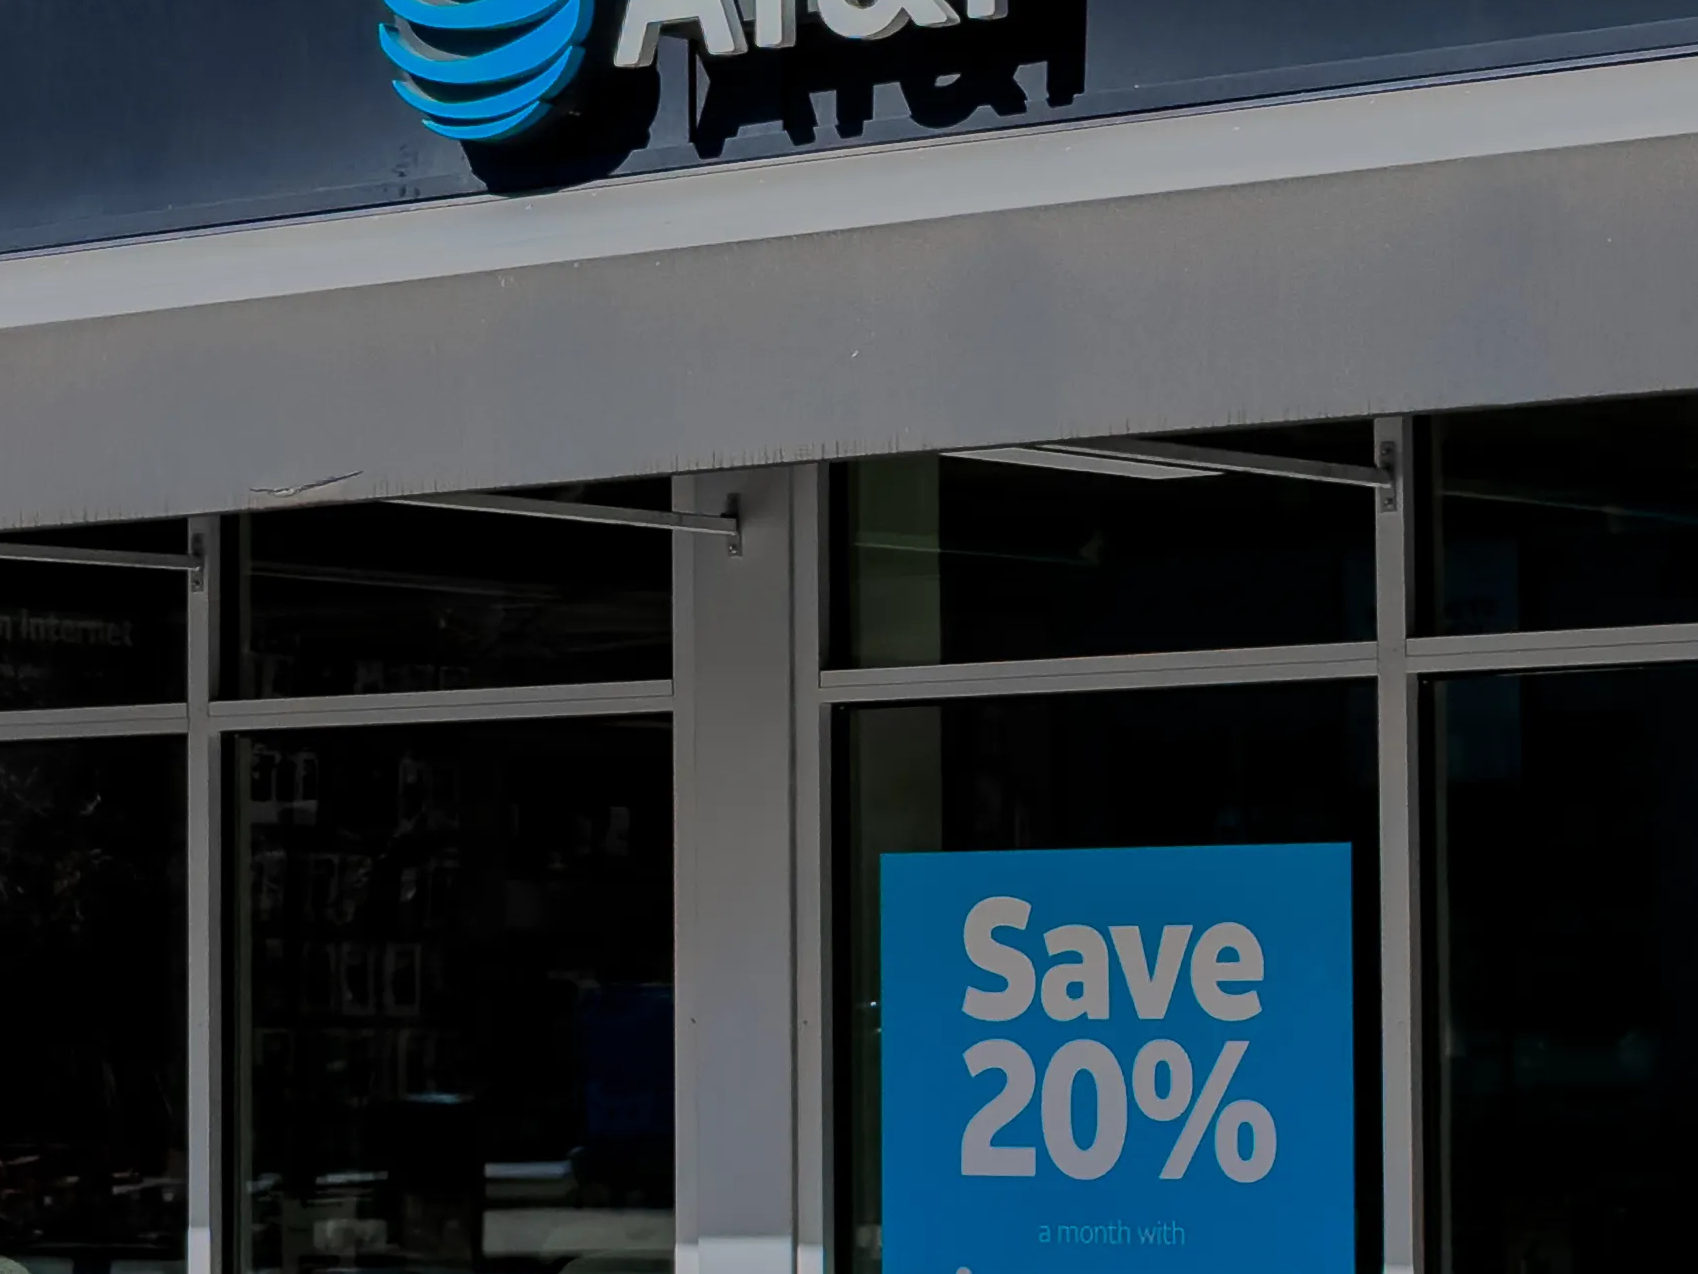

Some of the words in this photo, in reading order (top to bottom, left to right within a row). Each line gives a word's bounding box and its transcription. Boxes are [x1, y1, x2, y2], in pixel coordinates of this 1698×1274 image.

[961, 895, 1264, 1023] Save
[960, 1037, 1277, 1184] 20%
[1038, 1225, 1051, 1243] a
[1057, 1219, 1131, 1245] month
[1137, 1220, 1186, 1245] with
